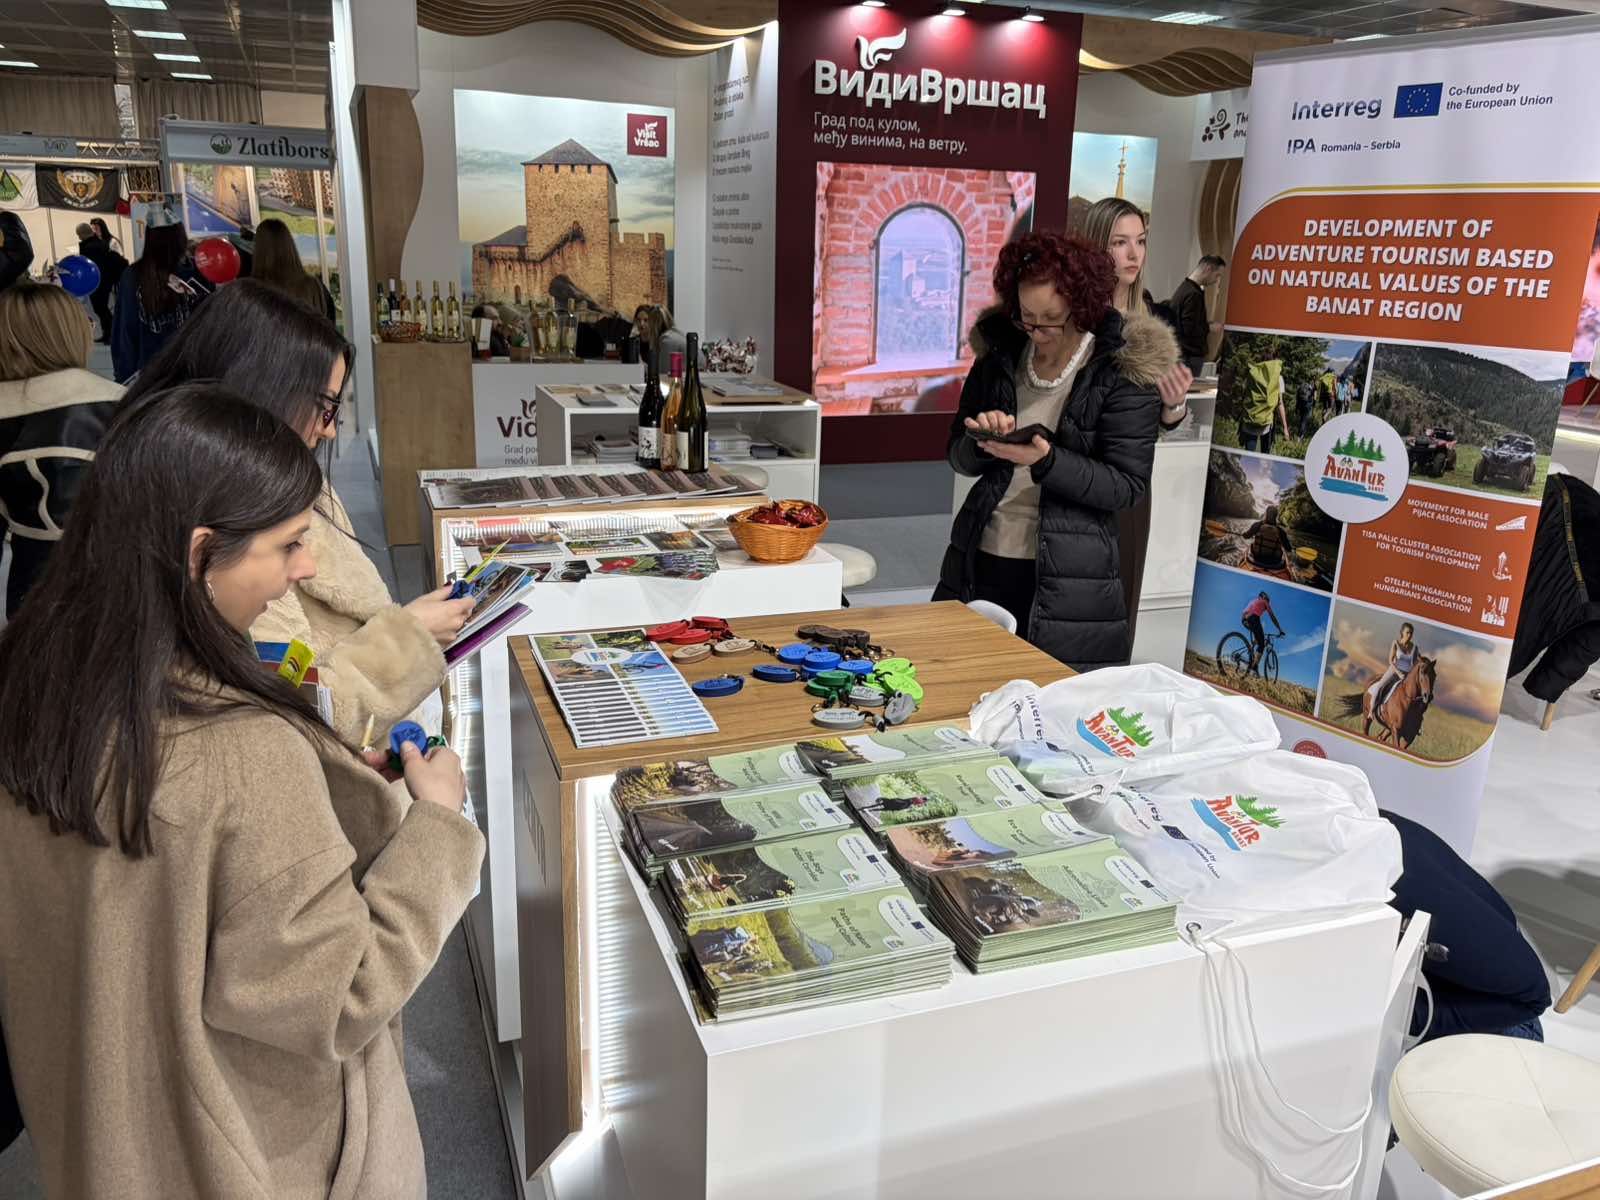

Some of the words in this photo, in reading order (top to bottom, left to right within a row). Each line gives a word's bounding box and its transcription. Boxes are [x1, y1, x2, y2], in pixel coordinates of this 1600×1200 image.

[814, 59, 1047, 120] ВидиВршац
[1448, 83, 1503, 96] Co-funded
[1506, 82, 1520, 95] by
[1292, 99, 1382, 121] Interreg
[1446, 100, 1462, 110] the
[1465, 97, 1516, 109] European
[1520, 95, 1553, 106] Union
[814, 112, 846, 129] Град
[850, 117, 875, 131] под
[878, 119, 921, 133] кулом,
[813, 130, 848, 148] међу
[851, 134, 906, 150] винима,
[909, 138, 925, 149] на
[929, 138, 968, 155] ветру.
[1287, 138, 1316, 154] IPA
[1321, 141, 1361, 152] Romania
[1370, 139, 1401, 150] Serbia
[1304, 219, 1457, 238] DEVELOPMENT
[1462, 218, 1493, 238] OF
[1251, 244, 1365, 263] ADVENTURE
[1370, 245, 1470, 266] TOURISM
[1475, 247, 1554, 269] BASED
[1248, 268, 1275, 285] ON
[1280, 269, 1372, 290] NATURAL
[1379, 272, 1462, 294] VALUES
[1466, 276, 1498, 296] OF
[1504, 277, 1550, 299] THE
[1305, 296, 1375, 316] BANAT
[1379, 299, 1462, 322] REGION
[526, 446, 539, 455] po
[1407, 499, 1449, 513] MOVEMENT
[1450, 506, 1466, 516] FOR
[1467, 510, 1489, 520] MALE
[1436, 513, 1487, 529] ASSOCIATION
[1362, 530, 1377, 539] TISA
[1378, 533, 1398, 544] PALIC
[1399, 538, 1430, 550] CLUSTER
[1430, 545, 1482, 562] ASSOCIATION
[1376, 541, 1390, 550] FOR
[1392, 543, 1424, 558] TOURISM
[1425, 552, 1480, 571] DEVELOPMENT
[1374, 582, 1421, 600] HUNGARIANS
[1422, 595, 1472, 613] ASSOCIATION
[1384, 576, 1411, 588] OTELEK
[1412, 582, 1456, 600] HUNGARIAN
[1457, 594, 1473, 604] FOR
